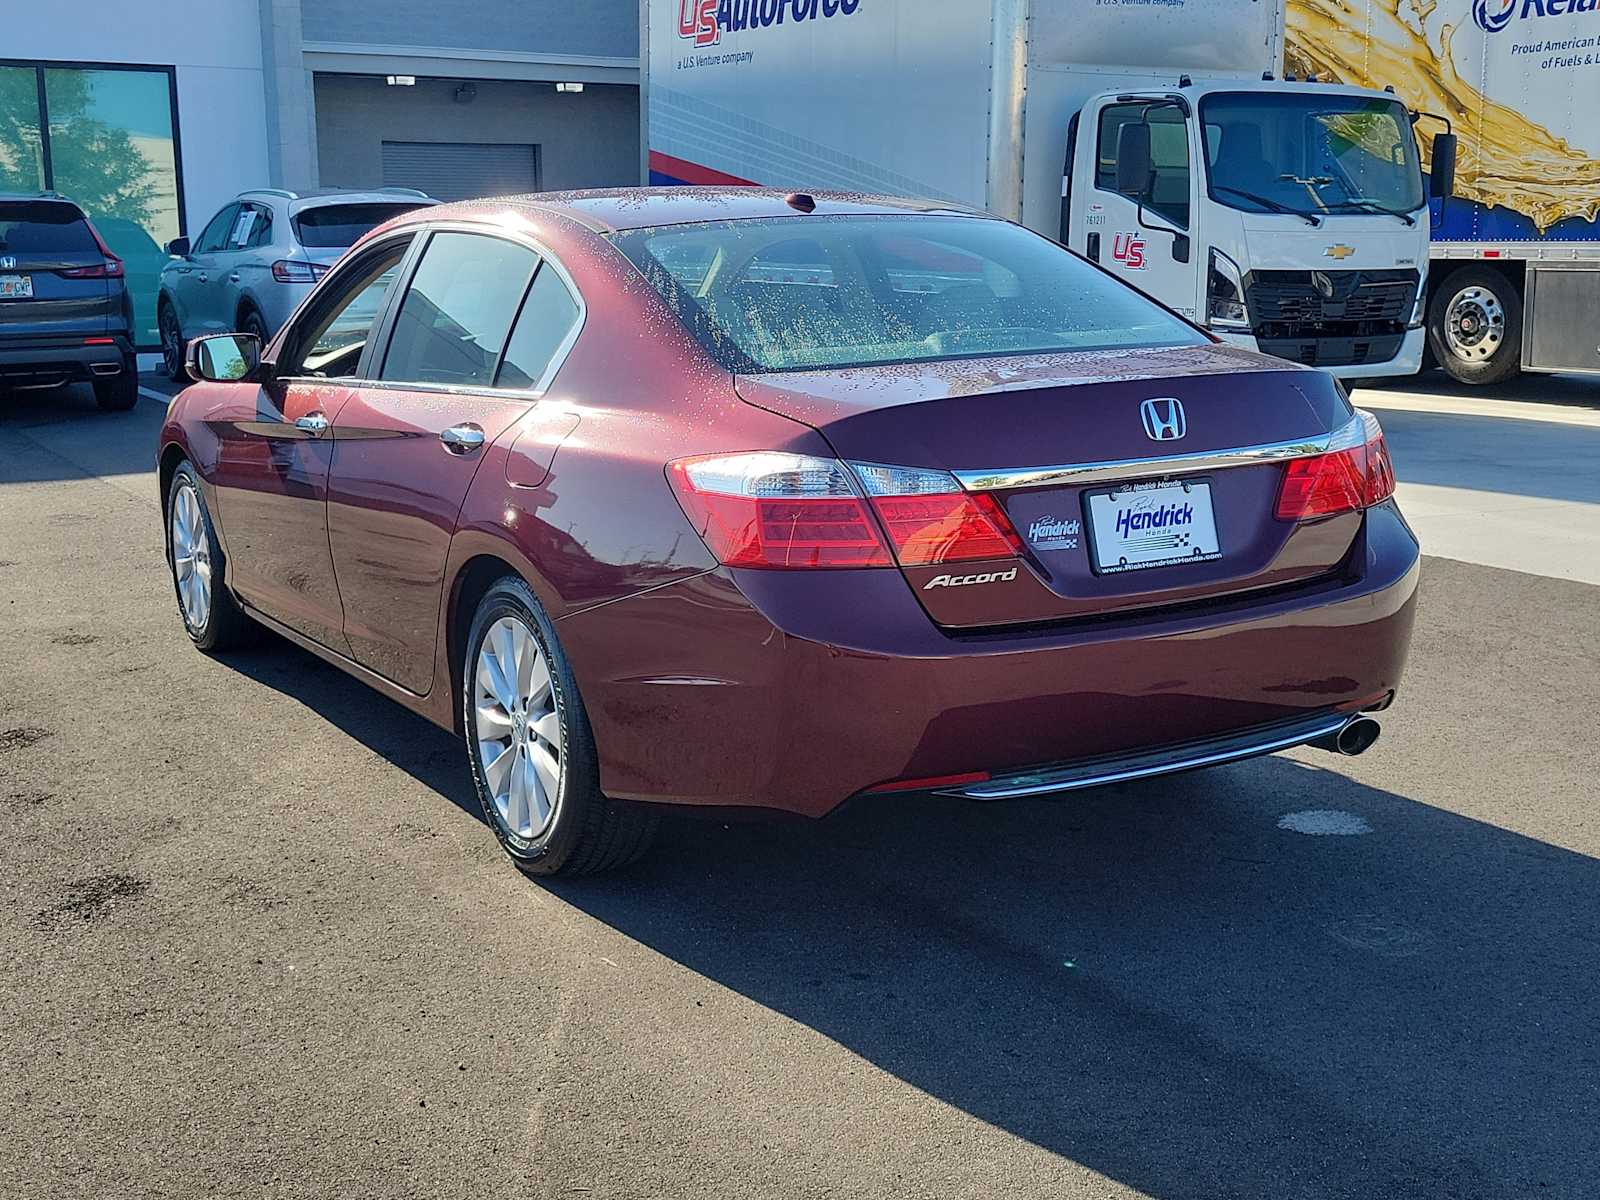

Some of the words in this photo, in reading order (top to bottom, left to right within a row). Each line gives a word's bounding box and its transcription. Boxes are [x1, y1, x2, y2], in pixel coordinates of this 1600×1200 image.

[1511, 41, 1543, 55] Proud
[1544, 37, 1594, 52] American
[696, 55, 721, 67] Venture
[722, 51, 754, 65] company
[1541, 57, 1554, 69] of
[1554, 55, 1582, 68] Fuels
[1584, 54, 1592, 65] &
[1157, 479, 1182, 488] Honda
[1116, 502, 1193, 539] Hendrick
[1028, 519, 1080, 542] Hendrick
[1145, 528, 1172, 537] Honda
[1101, 553, 1223, 574] www.RickHendrickHonda.com
[923, 567, 1018, 590] Accord
